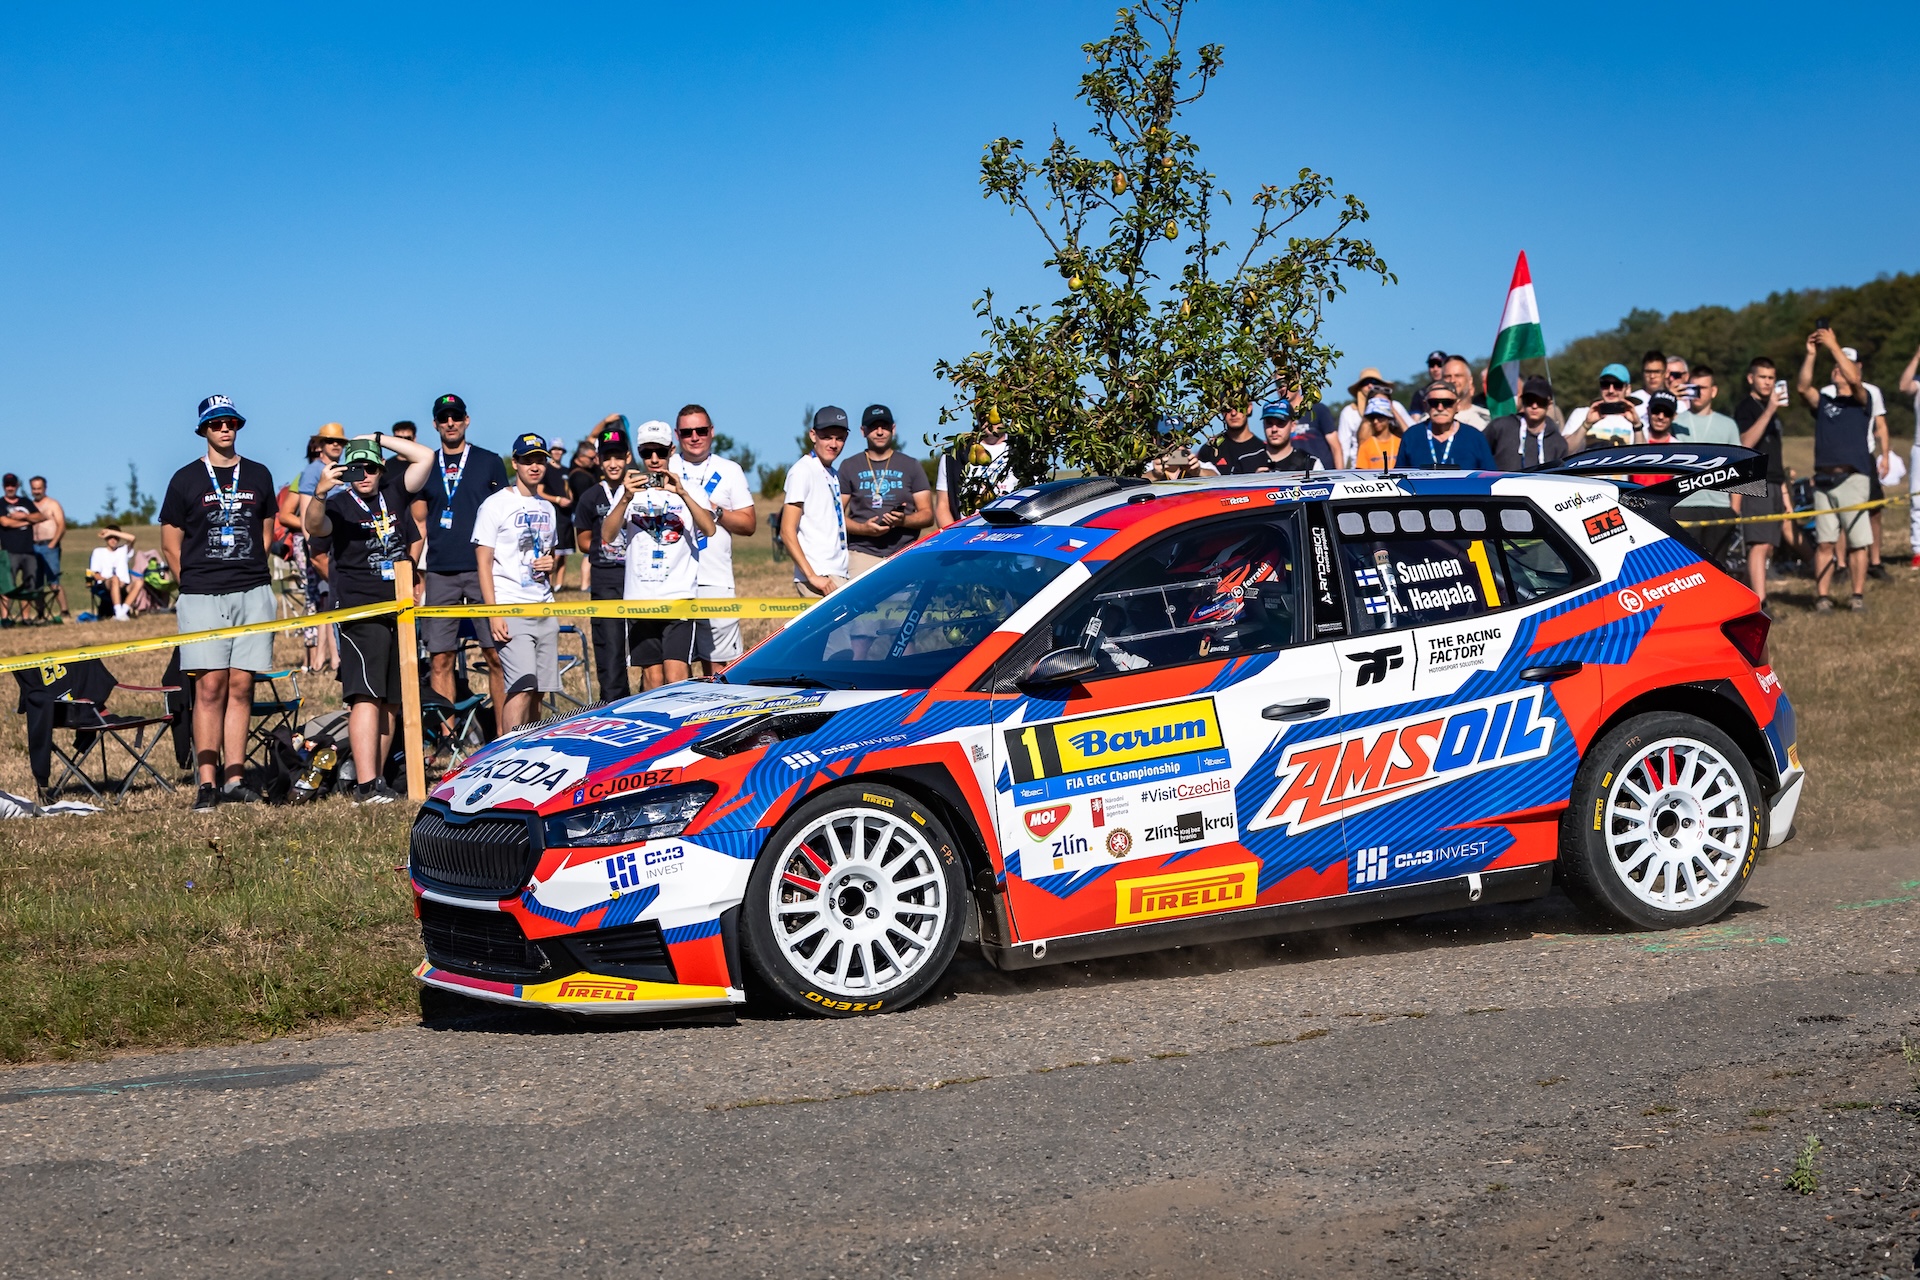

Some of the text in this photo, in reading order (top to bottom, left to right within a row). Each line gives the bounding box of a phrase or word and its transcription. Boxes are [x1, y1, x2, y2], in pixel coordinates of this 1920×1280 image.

[1267, 486, 1329, 501] auriol sport
[1343, 482, 1393, 495] halo.P1
[1554, 492, 1586, 512] auriol
[1583, 507, 1624, 536] ETS
[1589, 530, 1611, 543] RACING
[1396, 558, 1463, 584] Suninen
[1466, 540, 1502, 607] 1
[1641, 572, 1707, 602] ferratum
[1389, 582, 1477, 614] A. Haapala
[1428, 628, 1502, 650] THE RACING
[1429, 643, 1486, 665] FACTORY
[1428, 659, 1485, 674] MOTORSPORT SOLUTIONS
[731, 701, 765, 713] CZECH
[859, 734, 908, 747] INVEST
[1021, 718, 1206, 780] 1 Barum
[1260, 690, 1551, 829] AMSOIL
[1066, 761, 1181, 791] FIA ERC Championship
[862, 792, 895, 808] PIRELLI
[1106, 800, 1130, 811] sportovní
[1029, 810, 1057, 827] MOL
[1106, 809, 1129, 818] agentura
[1204, 812, 1234, 831] kraj
[644, 845, 685, 866] CM3
[1394, 841, 1489, 869] CM3 INVEST
[646, 862, 685, 879] INVEST
[1129, 872, 1246, 915] PIRELLI
[557, 980, 639, 1001] PIRELLI
